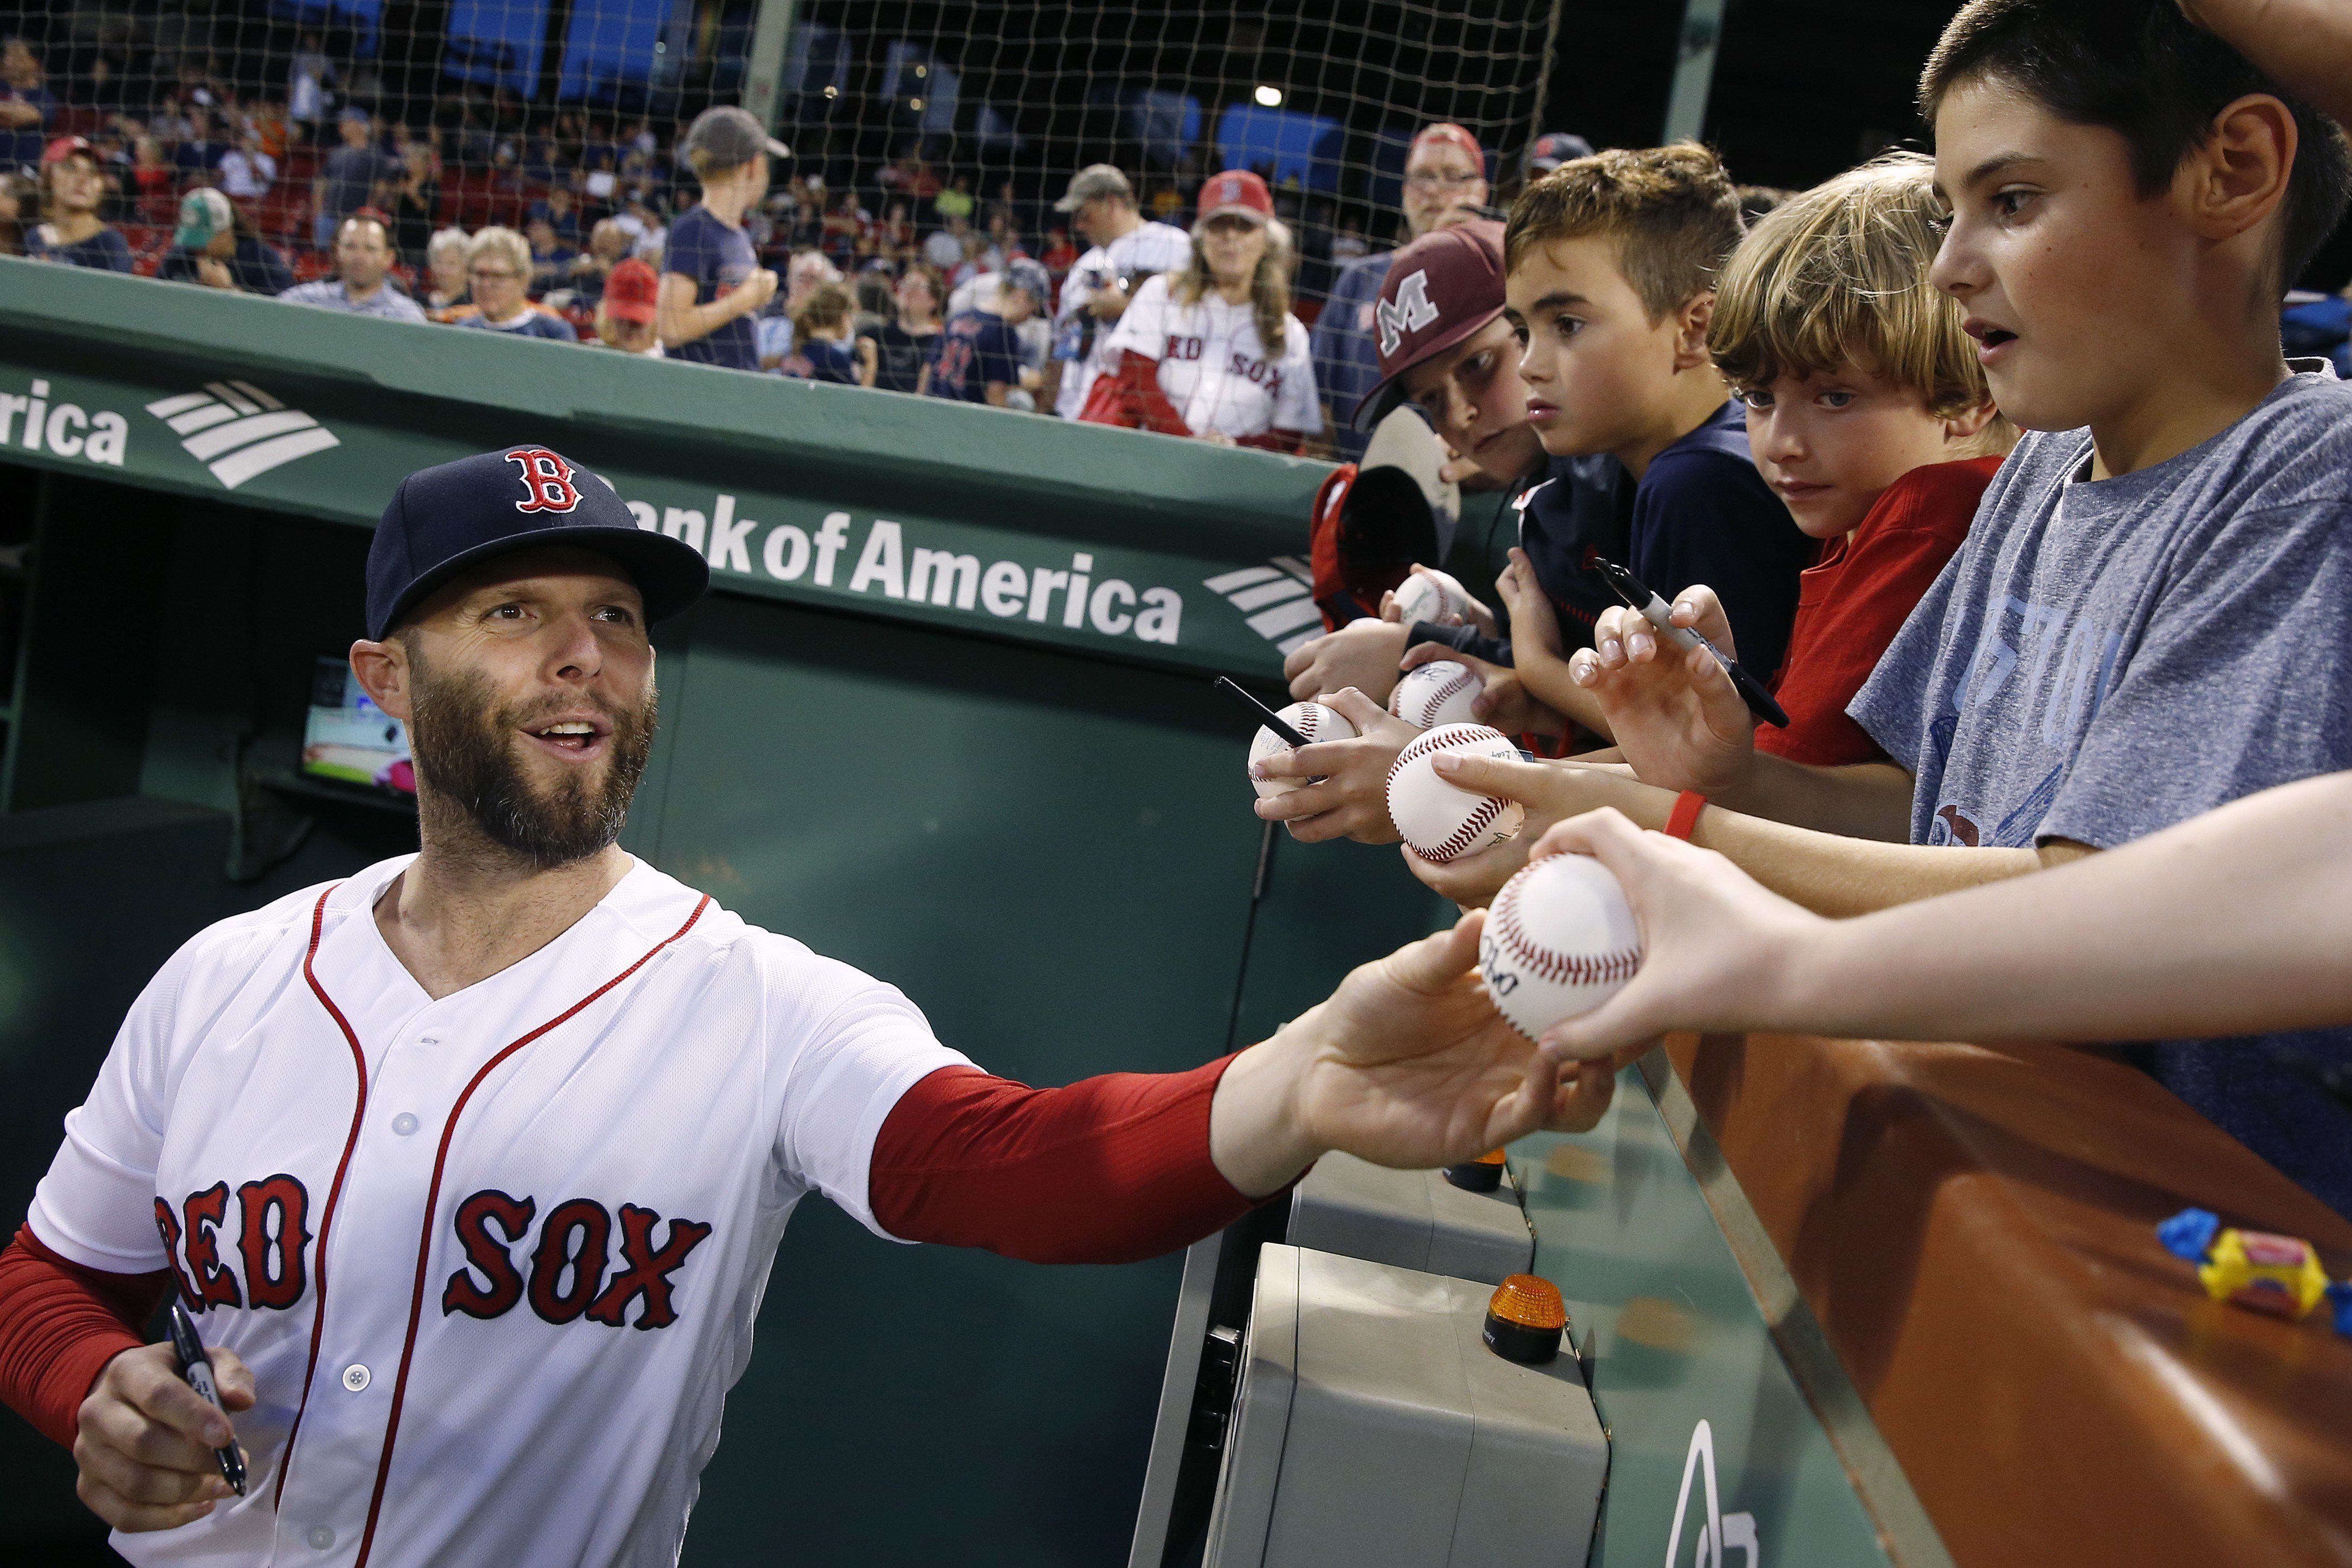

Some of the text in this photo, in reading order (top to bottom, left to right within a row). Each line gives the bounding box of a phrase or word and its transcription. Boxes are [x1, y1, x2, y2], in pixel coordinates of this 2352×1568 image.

[1376, 268, 1440, 359] M
[504, 449, 584, 514] B
[762, 511, 852, 587] of
[849, 519, 1184, 645] America
[154, 1173, 712, 1331] RED SOX
